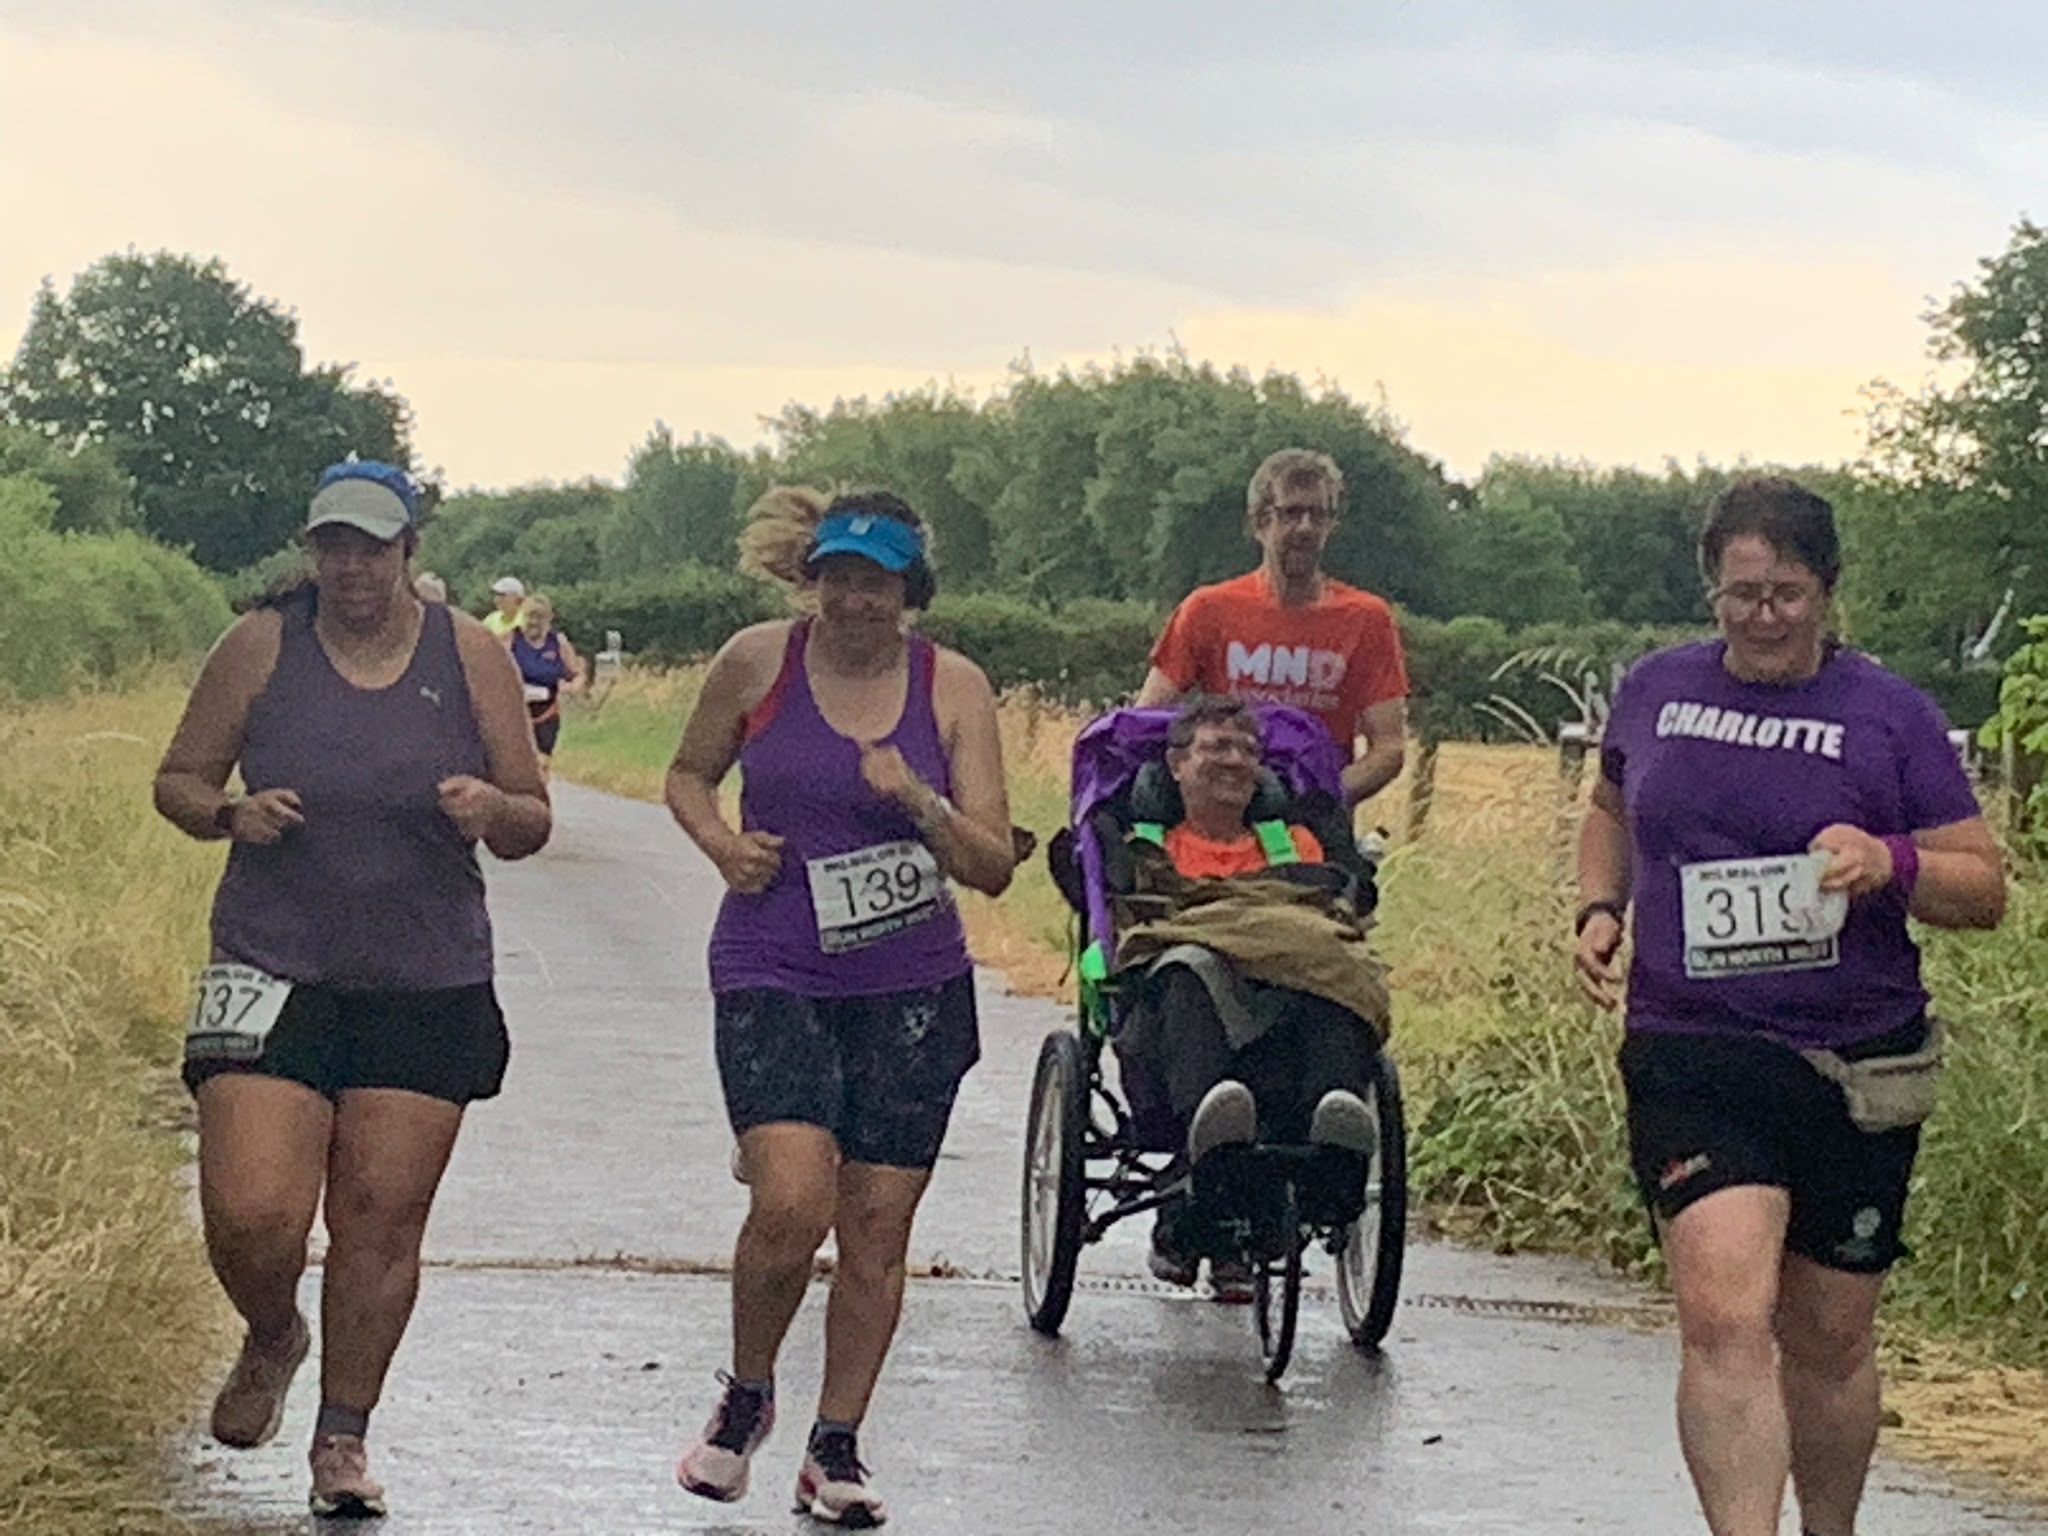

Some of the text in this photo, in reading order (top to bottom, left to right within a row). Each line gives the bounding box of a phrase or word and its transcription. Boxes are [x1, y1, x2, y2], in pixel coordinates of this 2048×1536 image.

[1227, 640, 1347, 690] MND
[1656, 702, 1846, 760] CHARLOTTE
[838, 861, 922, 918] 139
[195, 983, 264, 1029] 137
